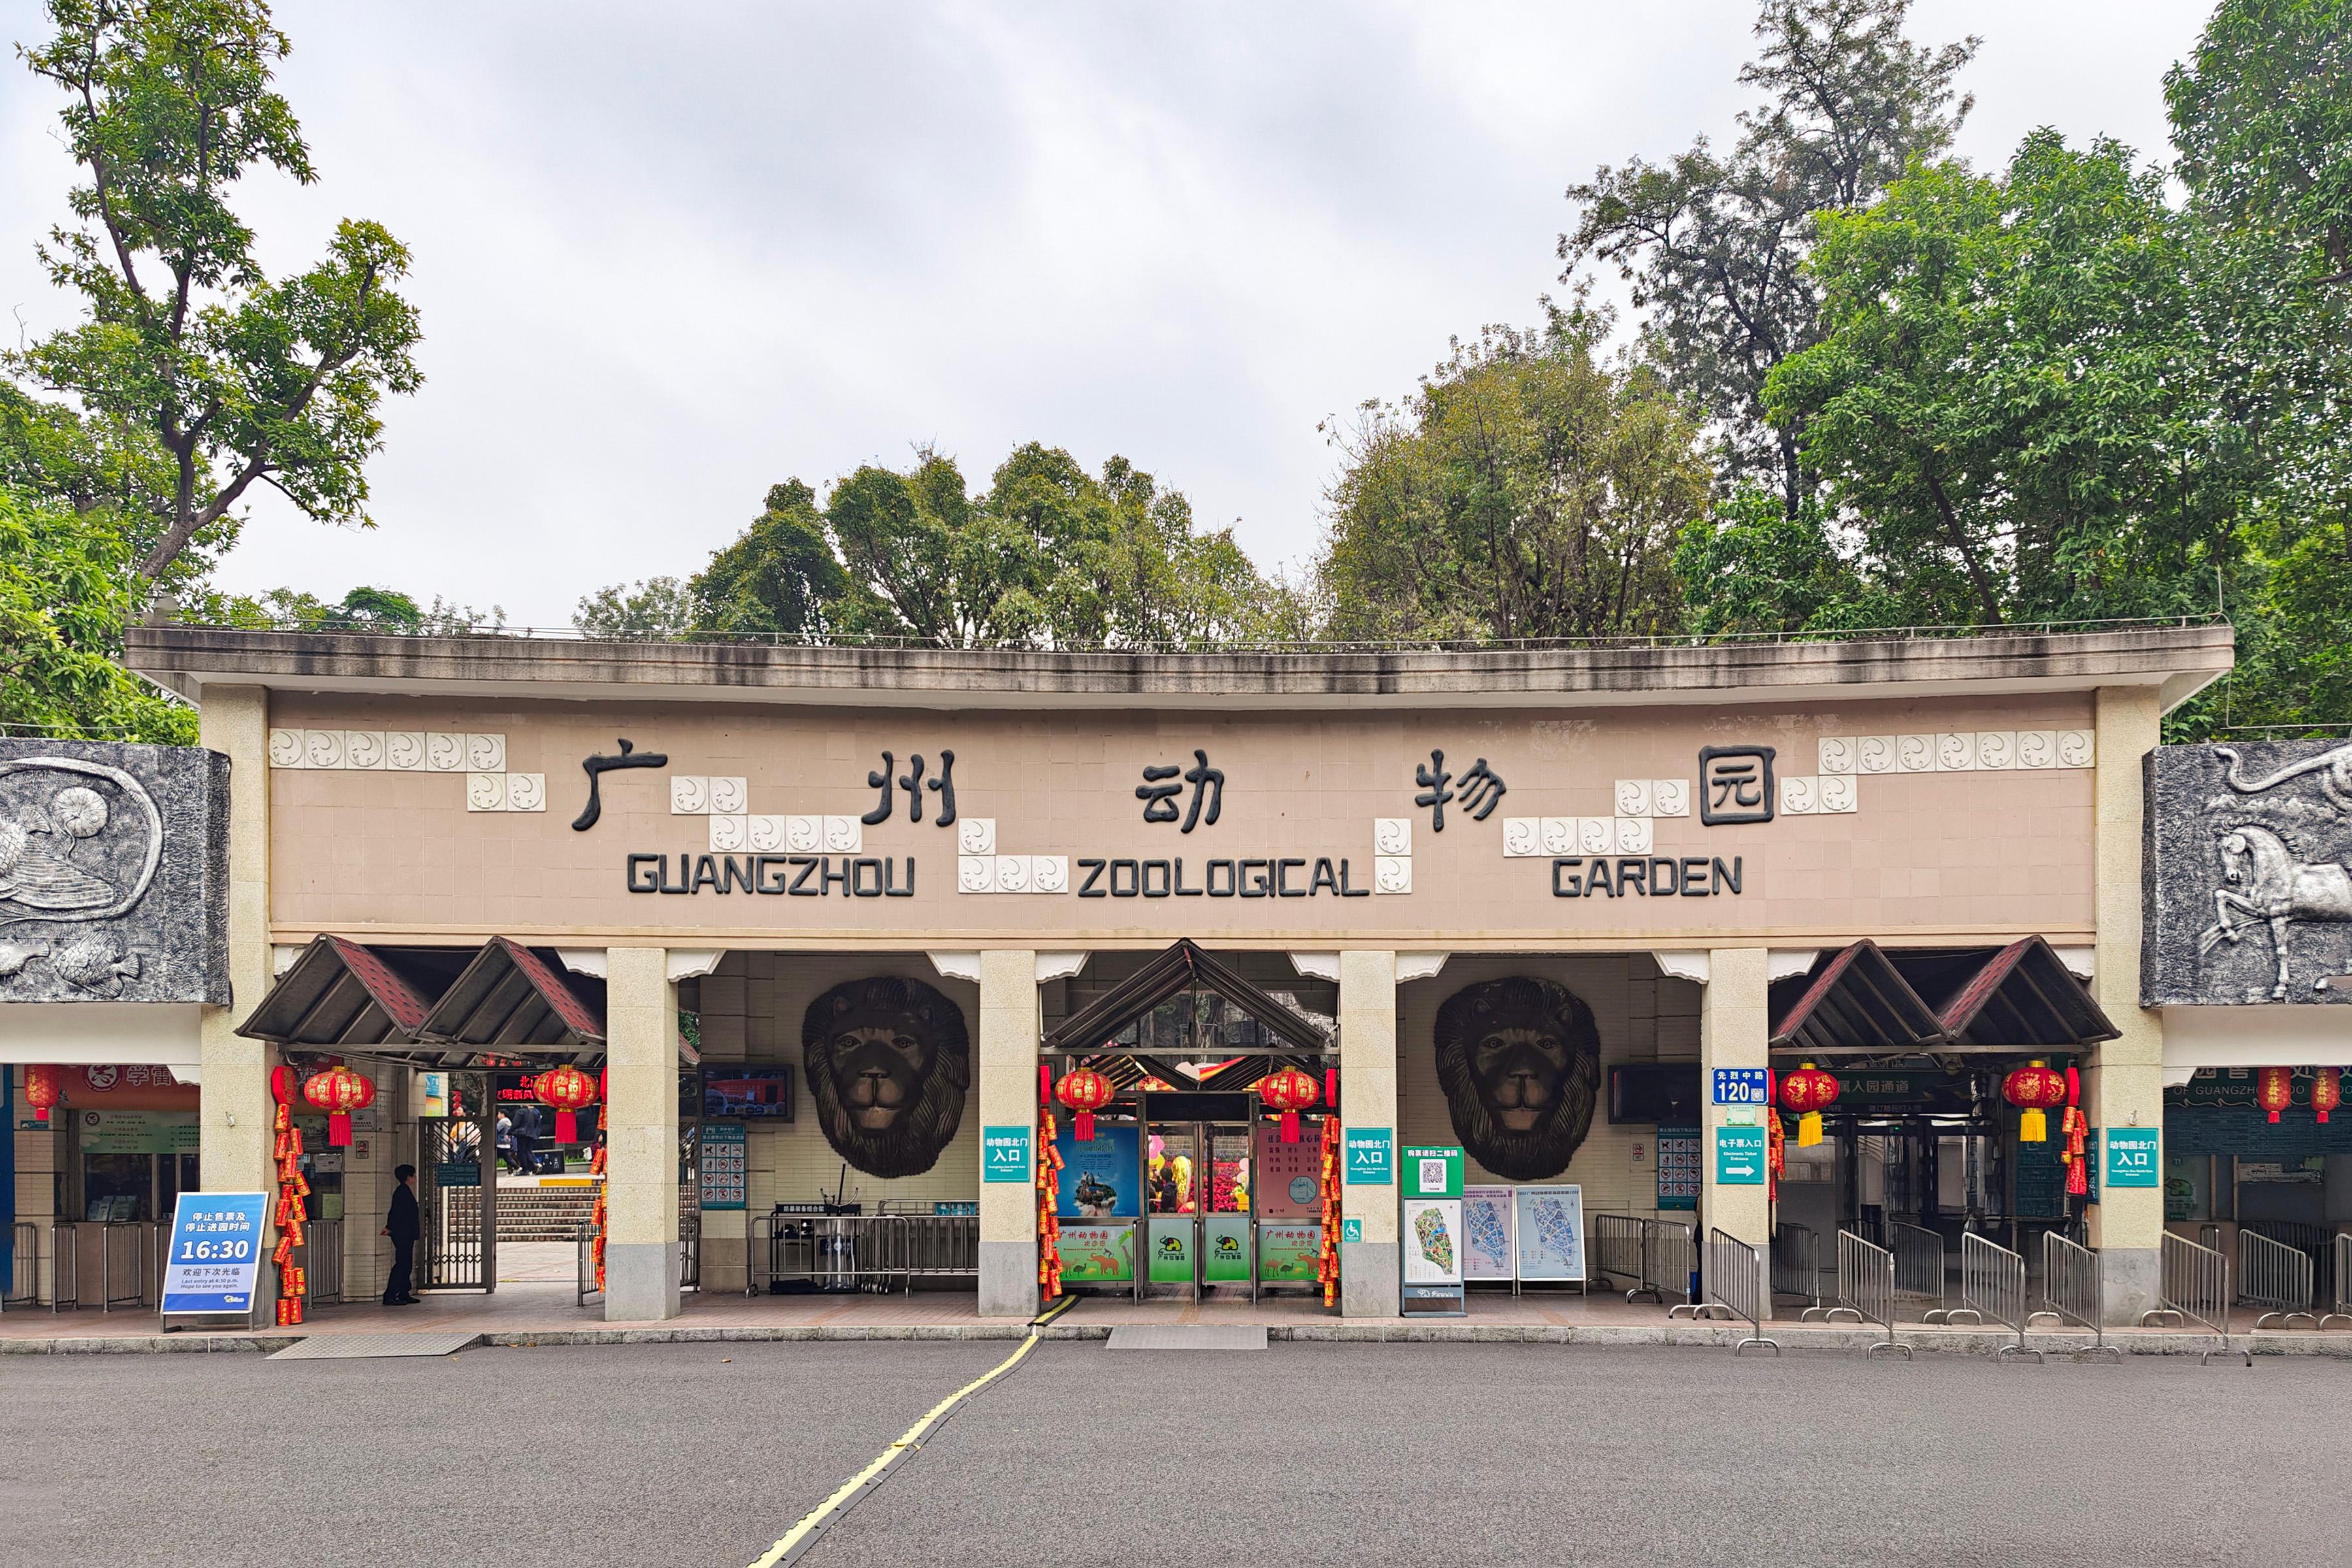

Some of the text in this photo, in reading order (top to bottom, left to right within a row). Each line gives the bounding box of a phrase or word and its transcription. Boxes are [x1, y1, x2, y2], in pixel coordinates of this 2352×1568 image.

[627, 853, 1742, 898] GUANGZHOU ZOOLOGICAL GARDEN
[1718, 1071, 1763, 1080] 先烈中路
[497, 1089, 533, 1100] 明新风
[1718, 1082, 1749, 1102] 120
[2195, 1085, 2259, 1095] GUANGZH
[986, 1137, 1028, 1147] 动物园北门
[1348, 1140, 1390, 1149] 动物园北门
[1719, 1139, 1761, 1148] 电子票入口
[2110, 1140, 2156, 1150] 动物园北门
[993, 1148, 1020, 1162] 入口
[1356, 1151, 1382, 1164] 入口
[2117, 1151, 2148, 1166] 入口
[192, 1212, 246, 1222] 停止售票及
[185, 1222, 250, 1232] 停止进园时间
[1265, 1230, 1315, 1241] 广州动物园
[180, 1239, 250, 1260] 16:30
[182, 1267, 240, 1277] 欢迎下次光临
